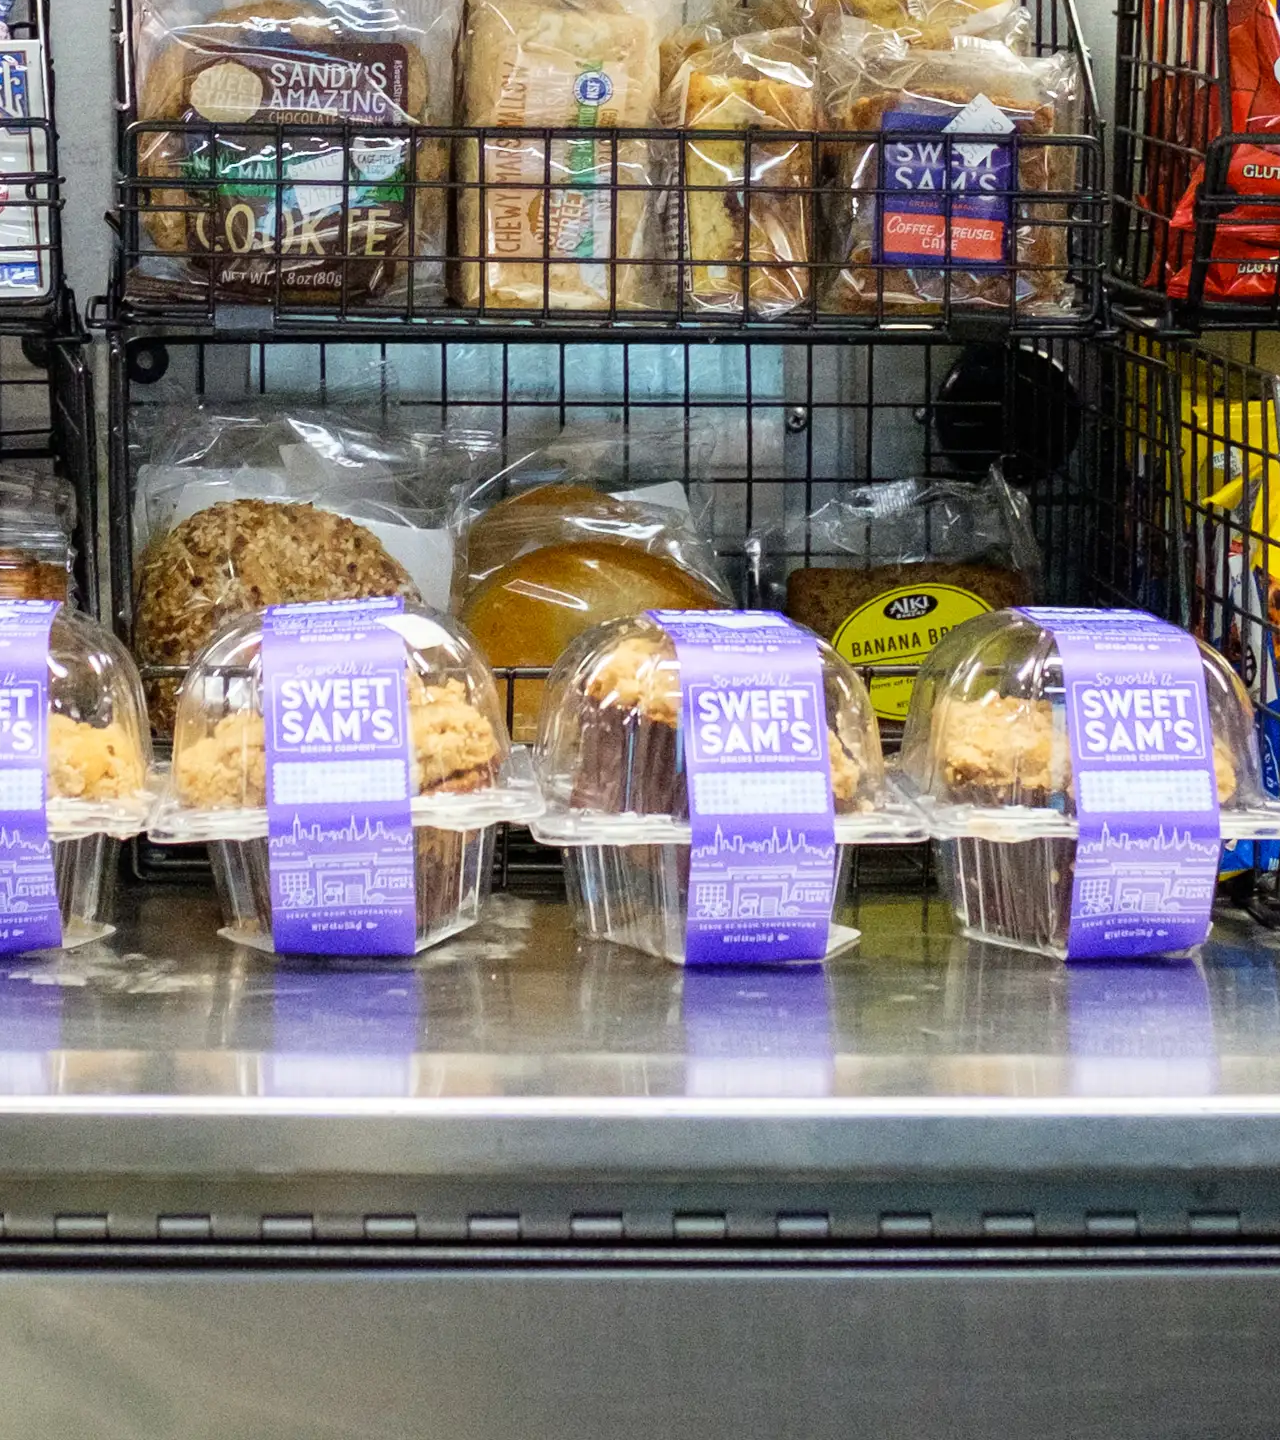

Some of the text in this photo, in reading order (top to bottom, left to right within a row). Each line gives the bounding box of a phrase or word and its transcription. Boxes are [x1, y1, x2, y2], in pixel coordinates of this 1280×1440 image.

[269, 62, 387, 89] SANDY'S
[269, 89, 387, 114] AMAZING
[887, 216, 935, 236] COFFEE
[889, 596, 929, 614] ALKI
[852, 632, 921, 657] BANANA
[280, 678, 392, 710] SWEET
[698, 689, 809, 722] SWEET
[1081, 689, 1192, 719] SWEET
[281, 708, 395, 744] SAM'S
[700, 720, 814, 754] SAM'S
[1084, 719, 1197, 752] SAM'S
